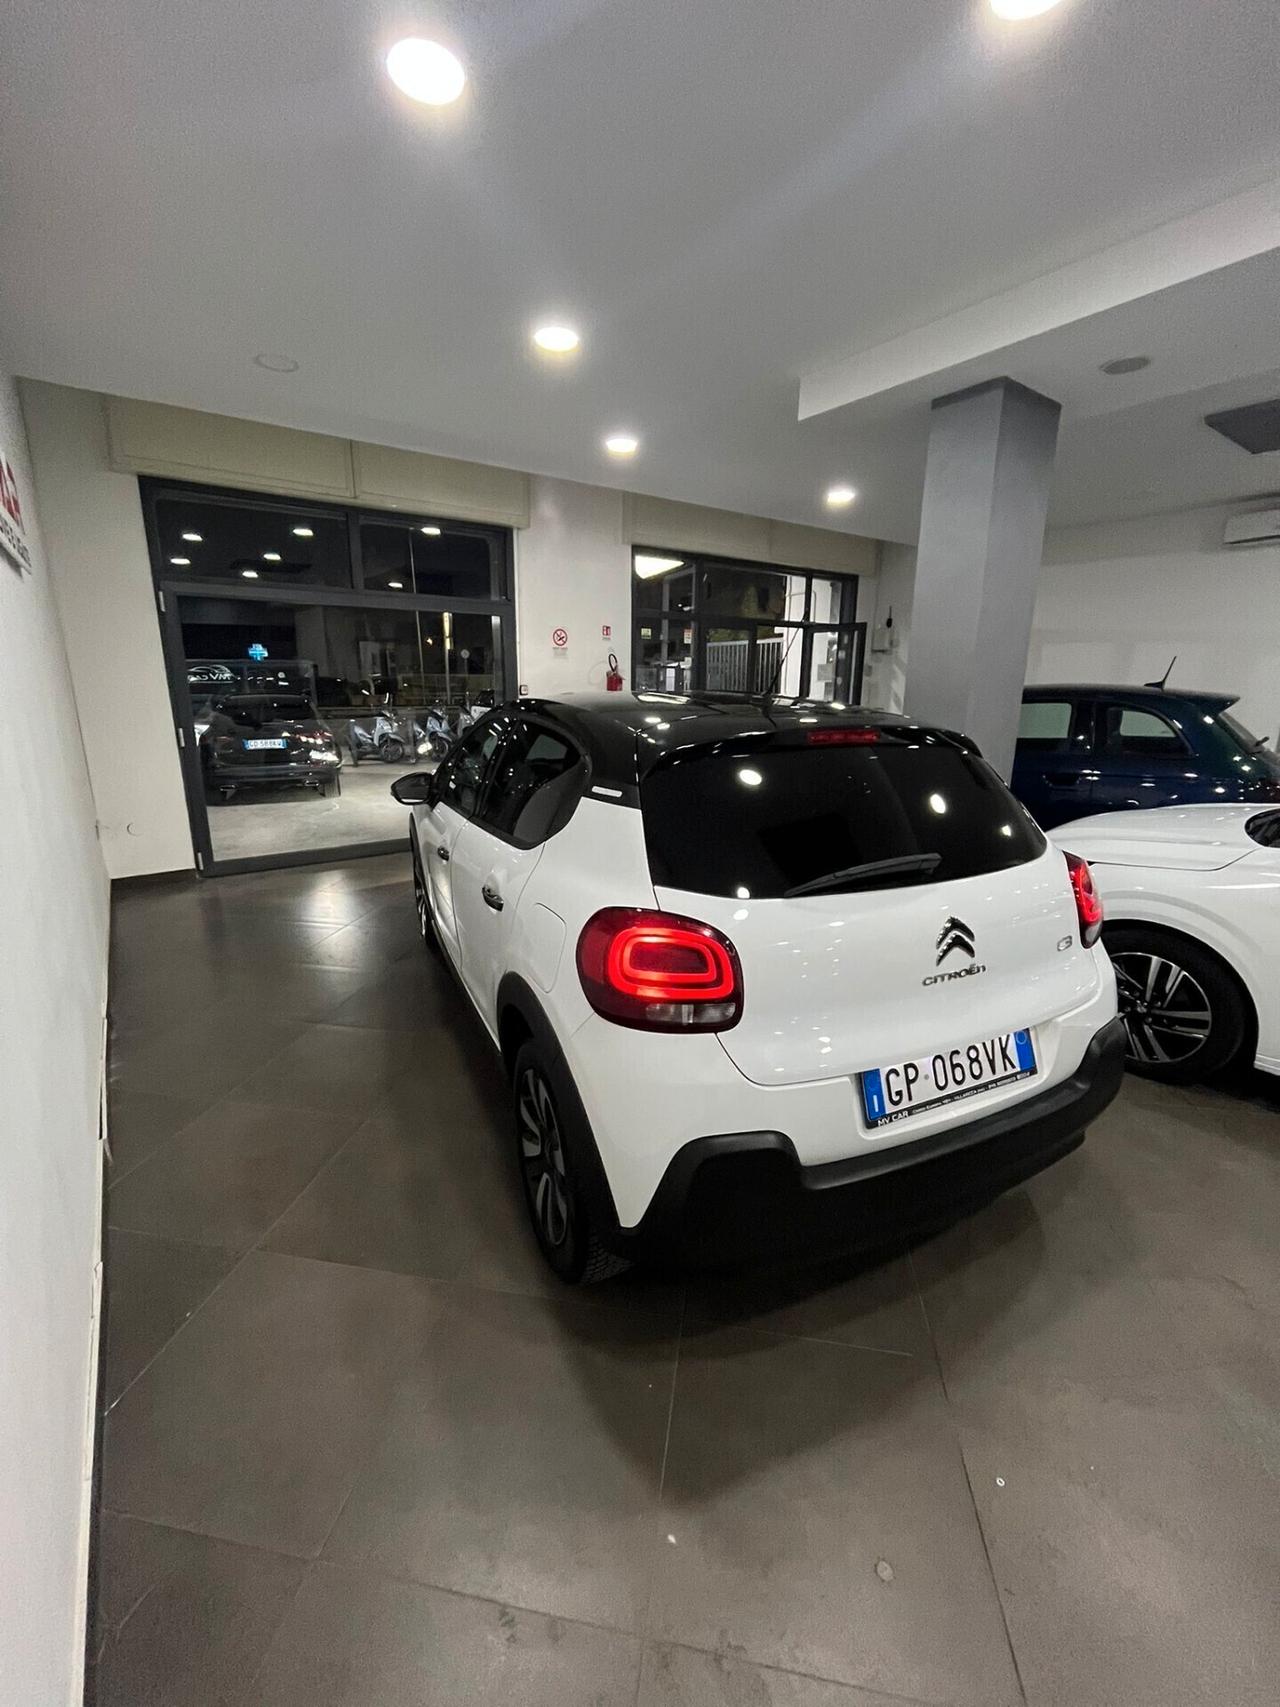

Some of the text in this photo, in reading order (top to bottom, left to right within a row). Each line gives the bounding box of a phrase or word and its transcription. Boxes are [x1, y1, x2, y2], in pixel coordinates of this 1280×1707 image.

[886, 1034, 1016, 1106] GP 068VK
[891, 1111, 909, 1121] CAR
